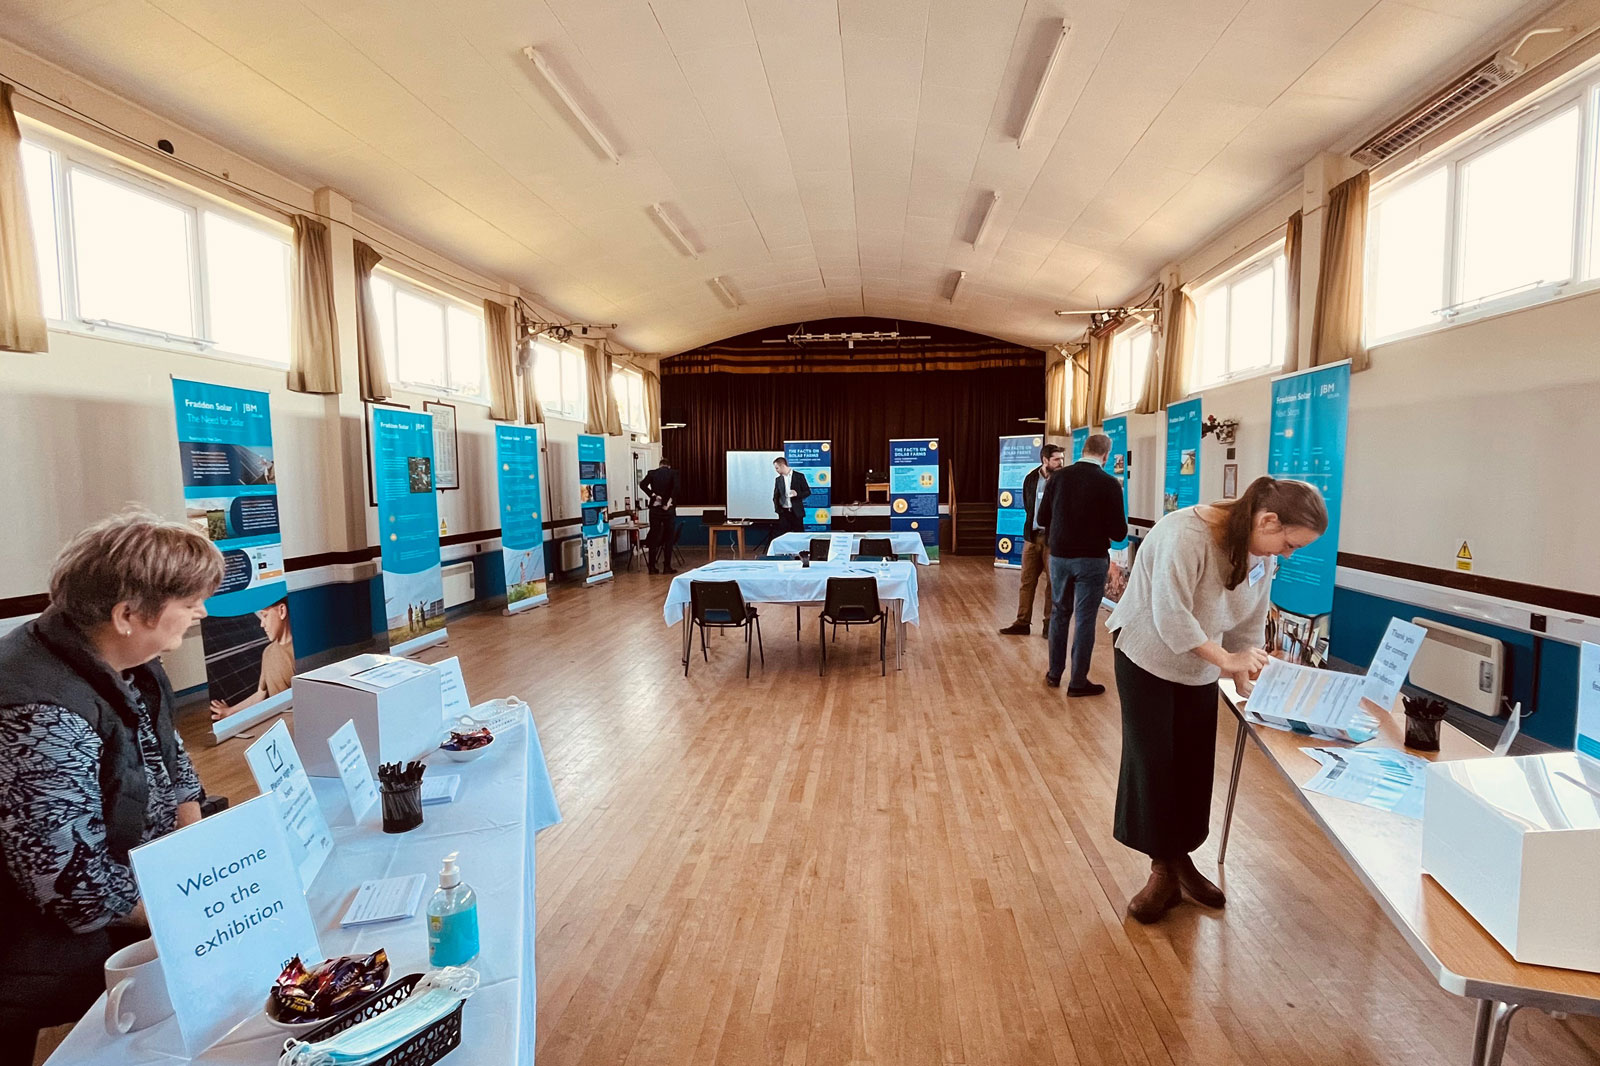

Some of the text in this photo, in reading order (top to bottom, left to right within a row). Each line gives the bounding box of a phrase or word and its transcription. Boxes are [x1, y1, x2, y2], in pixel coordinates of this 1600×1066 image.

[1320, 382, 1335, 397] JBM
[216, 402, 232, 412] Solar
[243, 403, 257, 414] JBM
[187, 413, 199, 423] The
[201, 416, 218, 424] Need
[1392, 629, 1405, 640] Thank
[1392, 647, 1408, 660] coming
[270, 776, 282, 792] Please
[283, 786, 294, 798] here
[177, 848, 267, 896] Welcome
[204, 882, 260, 918] to the
[194, 900, 284, 956] exhibition
